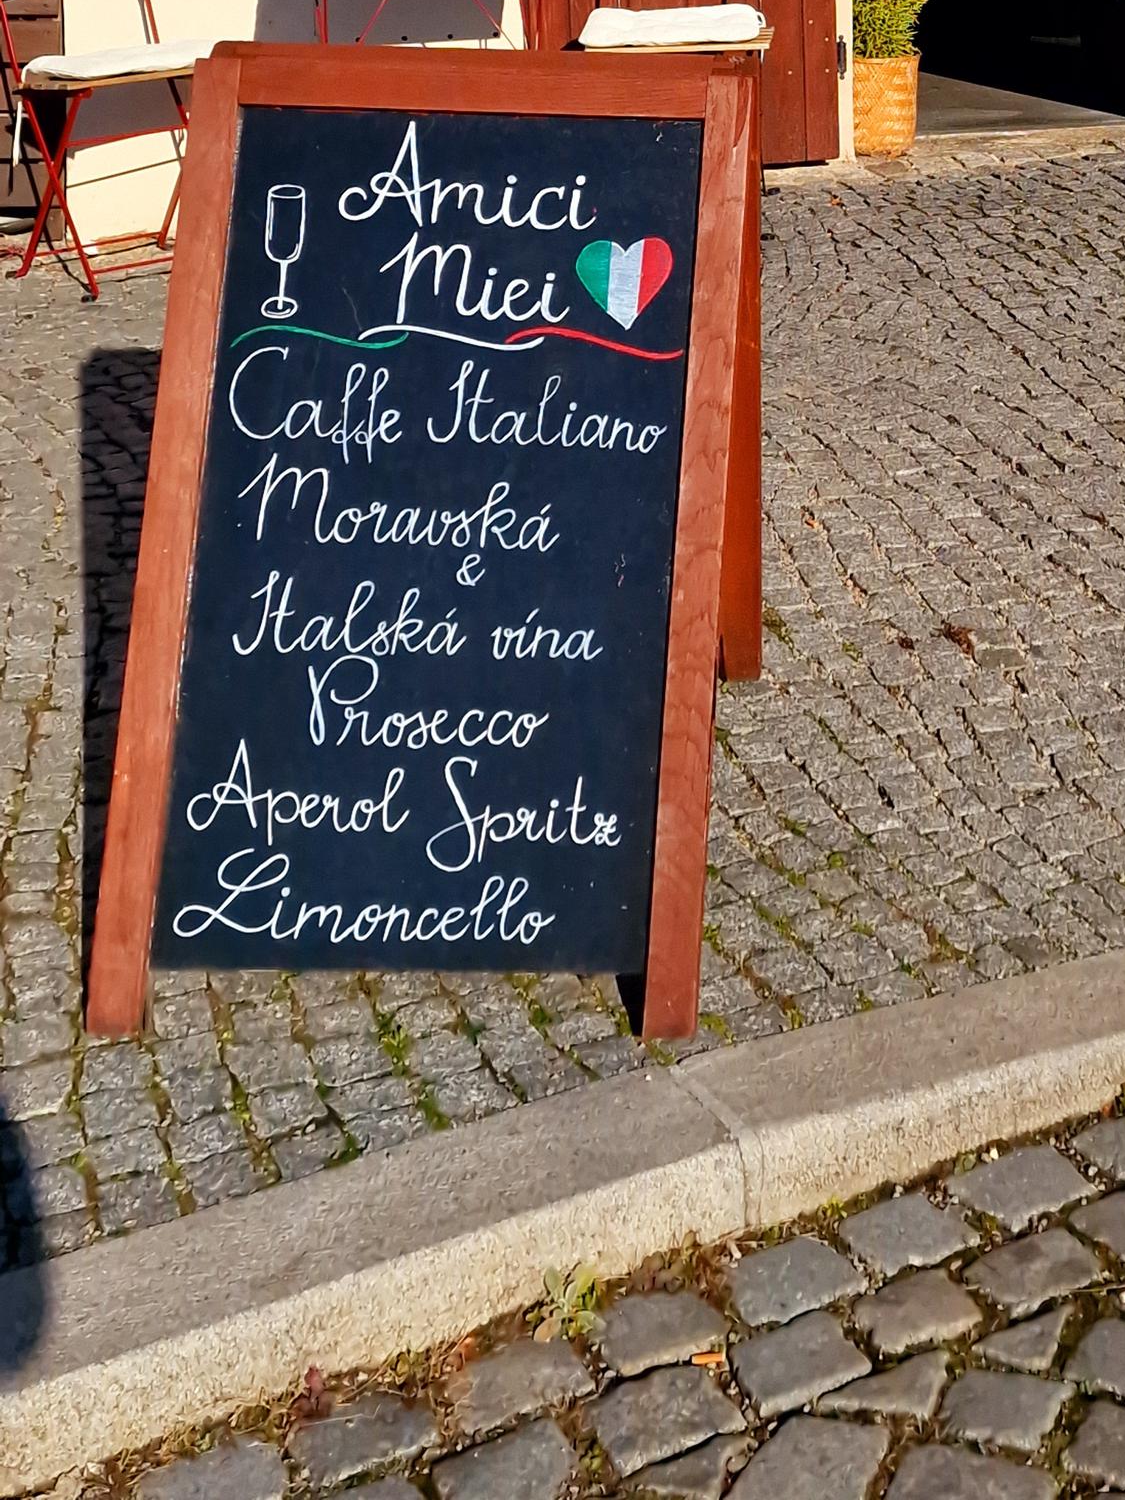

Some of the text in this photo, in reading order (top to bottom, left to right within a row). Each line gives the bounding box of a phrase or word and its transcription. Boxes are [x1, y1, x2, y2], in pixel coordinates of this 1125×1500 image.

[338, 120, 596, 230] Amici
[380, 231, 570, 323] Miei
[229, 346, 667, 464] Caffe Italiano
[238, 453, 560, 552] Moravská
[232, 570, 603, 661] Italská vína
[456, 553, 485, 586] &
[308, 655, 549, 749] Prosecco
[187, 739, 621, 872] Aperol Spritz
[173, 848, 555, 944] Limoncello
